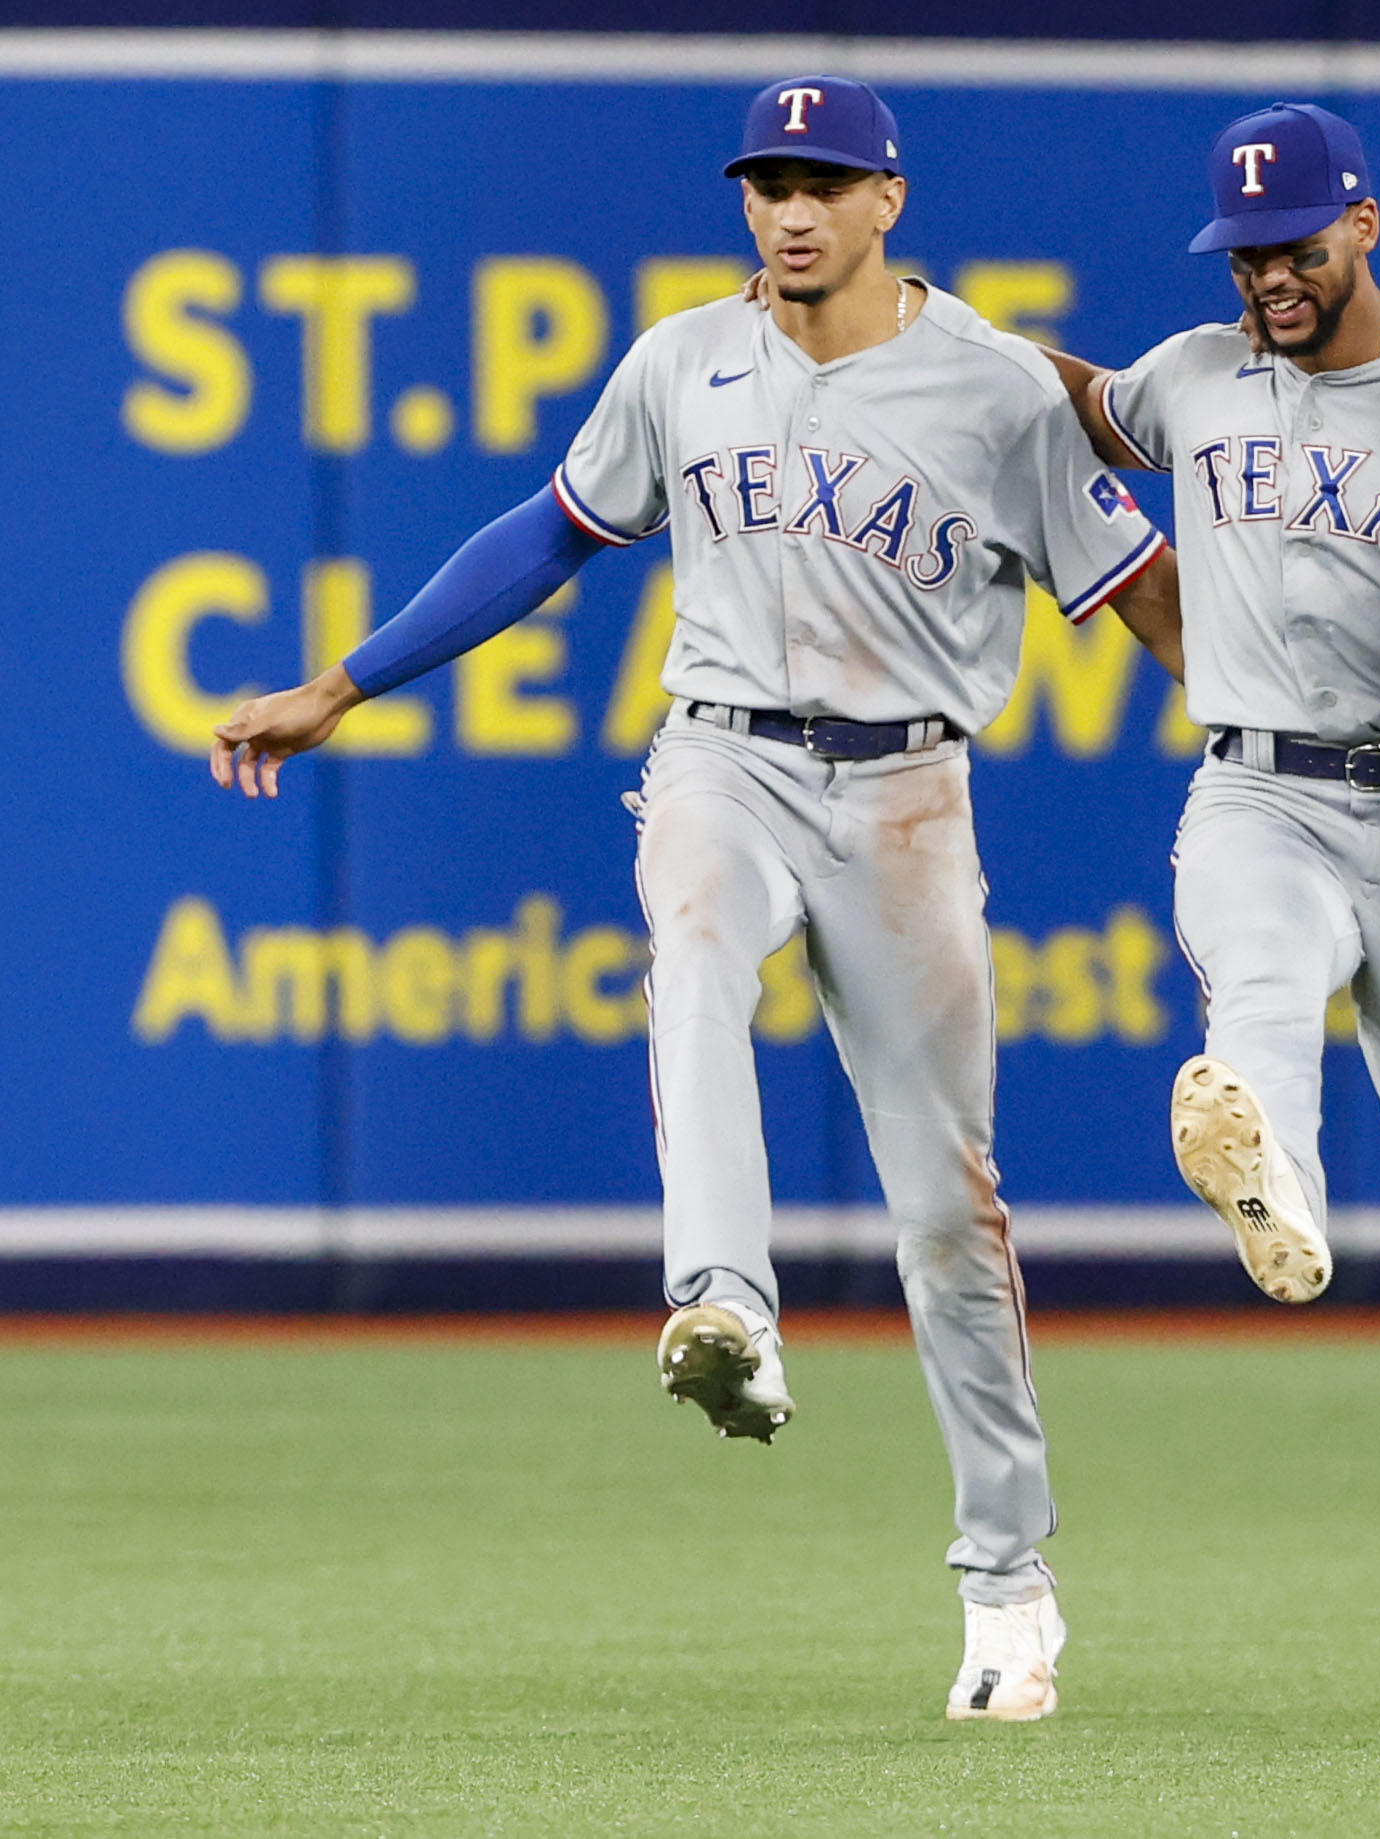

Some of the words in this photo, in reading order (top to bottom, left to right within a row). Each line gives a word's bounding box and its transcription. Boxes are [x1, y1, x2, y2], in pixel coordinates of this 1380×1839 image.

[777, 87, 825, 133] T
[1232, 142, 1278, 198] T
[679, 443, 979, 592] TEXAS
